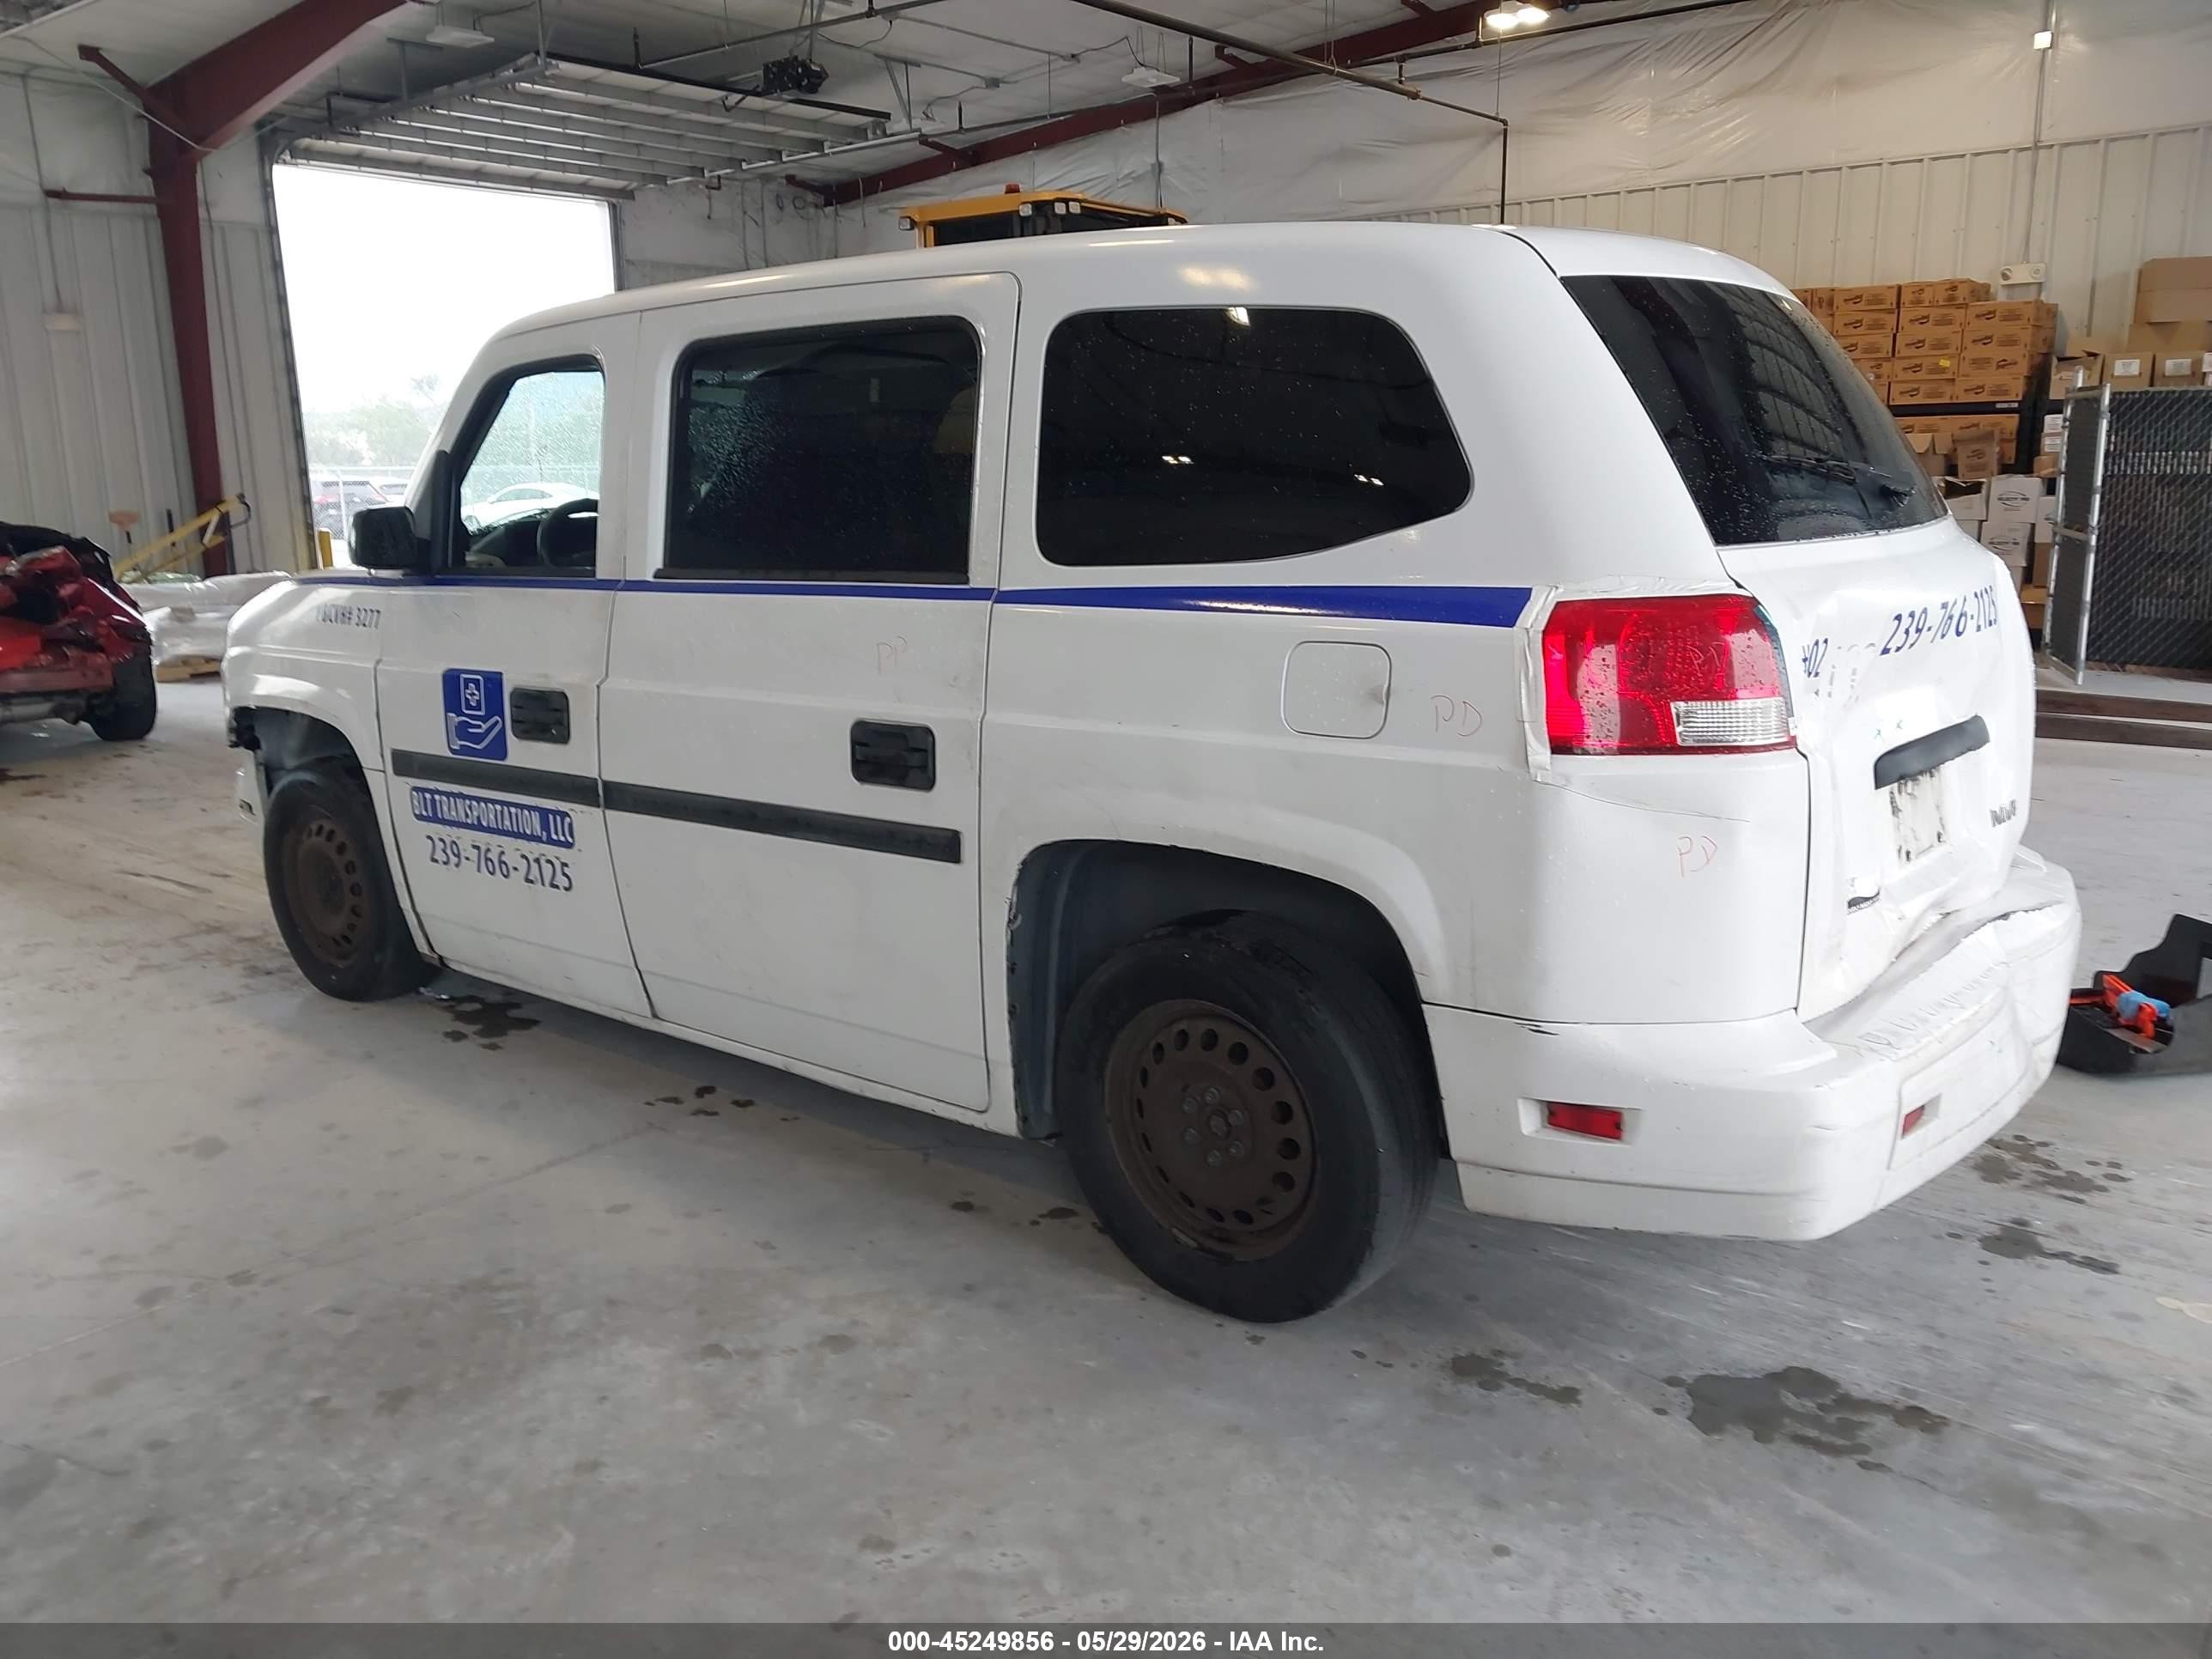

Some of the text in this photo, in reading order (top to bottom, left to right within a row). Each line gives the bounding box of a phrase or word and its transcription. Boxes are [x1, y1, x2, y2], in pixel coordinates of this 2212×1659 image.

[355, 606, 381, 629] 3277
[1430, 694, 1483, 737] PD
[434, 793, 548, 842] TRANSPORTATION,
[548, 812, 574, 843] LLC
[425, 834, 574, 892] 239-766-2125
[1677, 835, 1718, 878] PD
